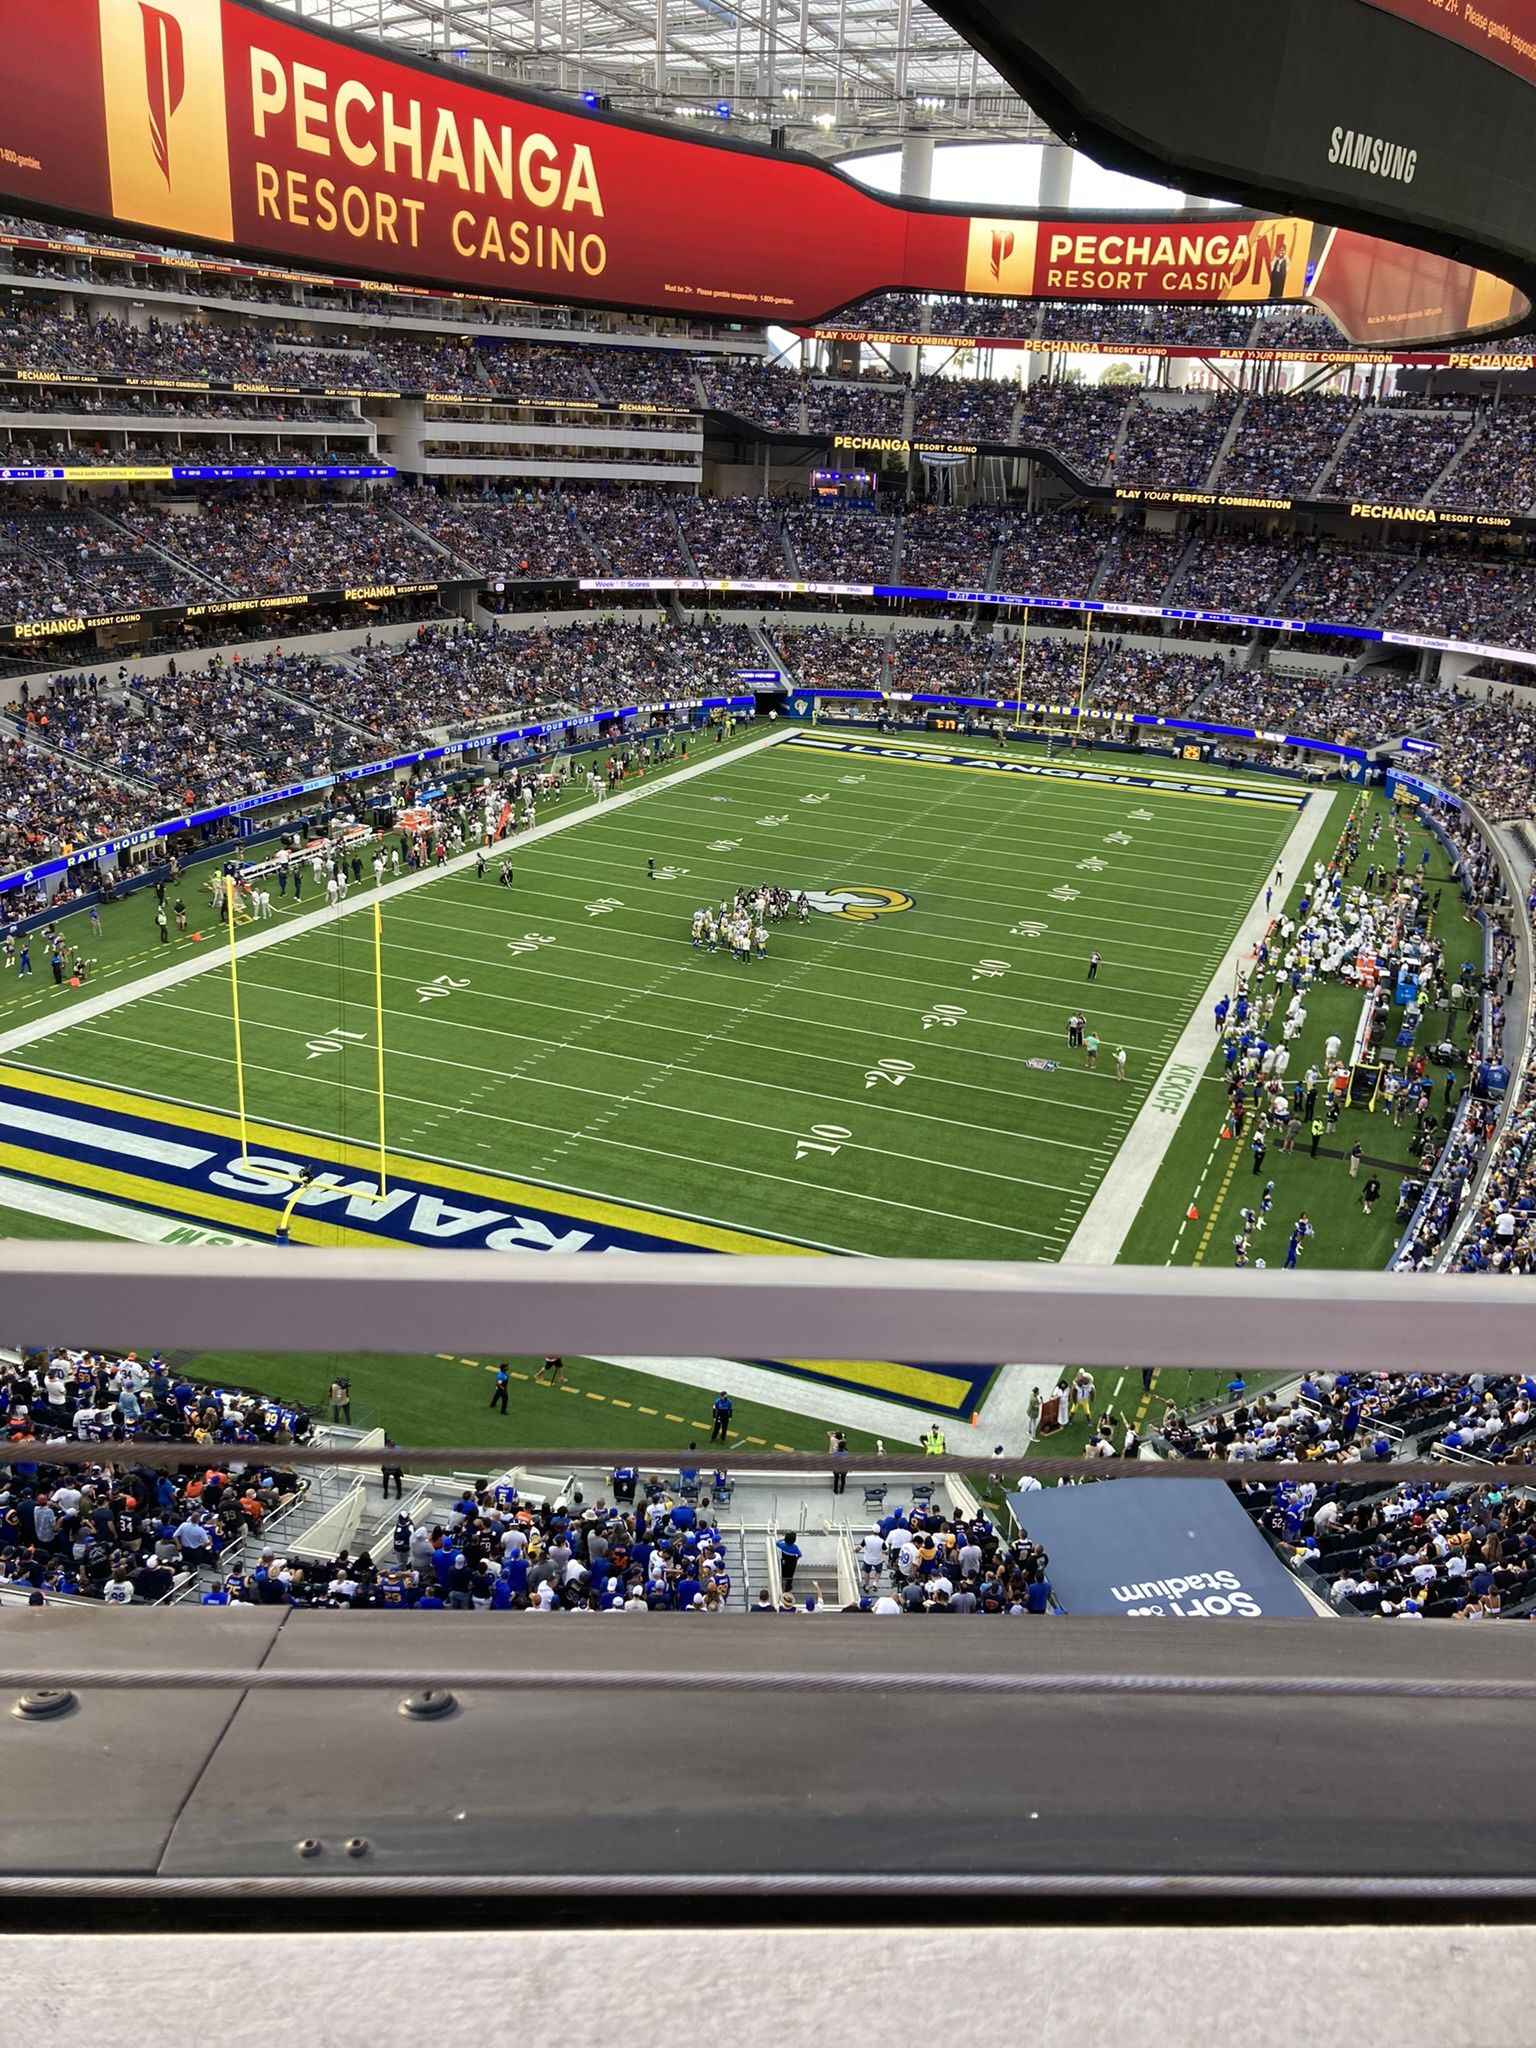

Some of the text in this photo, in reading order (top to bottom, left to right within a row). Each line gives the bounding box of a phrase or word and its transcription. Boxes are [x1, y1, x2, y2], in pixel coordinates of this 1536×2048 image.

[1464, 3, 1488, 31] Please
[1487, 20, 1511, 45] gamble
[249, 46, 605, 217] PECHANGA
[1328, 126, 1417, 184] SAMSUNG
[256, 161, 607, 276] RESORT CASINO
[48, 242, 62, 250] PLAY
[77, 246, 99, 256] PERFECT
[100, 249, 135, 260] COMBINATION
[1050, 234, 1251, 266] PECHANGA
[161, 256, 199, 269] PECHANGA
[360, 281, 398, 293] PECHANGA
[1048, 269, 1148, 290] RESORT
[696, 287, 713, 296] Please
[713, 290, 730, 298] gamble
[815, 330, 976, 347] PLAY YOUR PERFECT COMBINATION
[1024, 340, 1167, 355] PECHANGA RESORT CASINO
[1219, 349, 1393, 363] PLAY YOUR PERFECT COMBINATION
[1449, 354, 1534, 368] PECHANGA
[17, 371, 61, 381] PECHANGA
[175, 381, 210, 389] COMBINATION
[233, 383, 269, 393] PECHANGA
[426, 393, 462, 402] PECHANGA
[619, 403, 657, 412] PECHANGA
[834, 436, 977, 453] PECHANGA RESORT CASINO
[1116, 489, 1292, 510] PLAY YOUR PERFECT COMBINATION
[1350, 504, 1511, 527] PECHANGA RESORT CASINO
[345, 585, 396, 600] PECHANGA
[187, 595, 308, 616] PLAY YOUR PERFECT COMBINATION
[15, 613, 141, 638] PECHANGA RESORT CASINO
[637, 699, 703, 713] RAMS HOUSE
[1026, 703, 1134, 723] RAMS HOUSE
[443, 744, 463, 754] OUR
[848, 746, 1229, 796] LOS ANGELES
[67, 829, 156, 867] RAMS HOUSE
[1016, 920, 1049, 938] 50
[507, 932, 556, 953] 30
[973, 958, 1012, 979] 40
[416, 974, 471, 999] 20
[922, 1004, 968, 1028] 30
[305, 1027, 368, 1053] 10
[865, 1058, 916, 1087] 20
[1151, 1063, 1199, 1116] KICKOFF
[797, 1124, 853, 1156] 10
[208, 1156, 596, 1252] RAMS
[119, 1520, 133, 1533] 34
[1272, 1518, 1283, 1529] 52
[1111, 1570, 1241, 1602] Stadium
